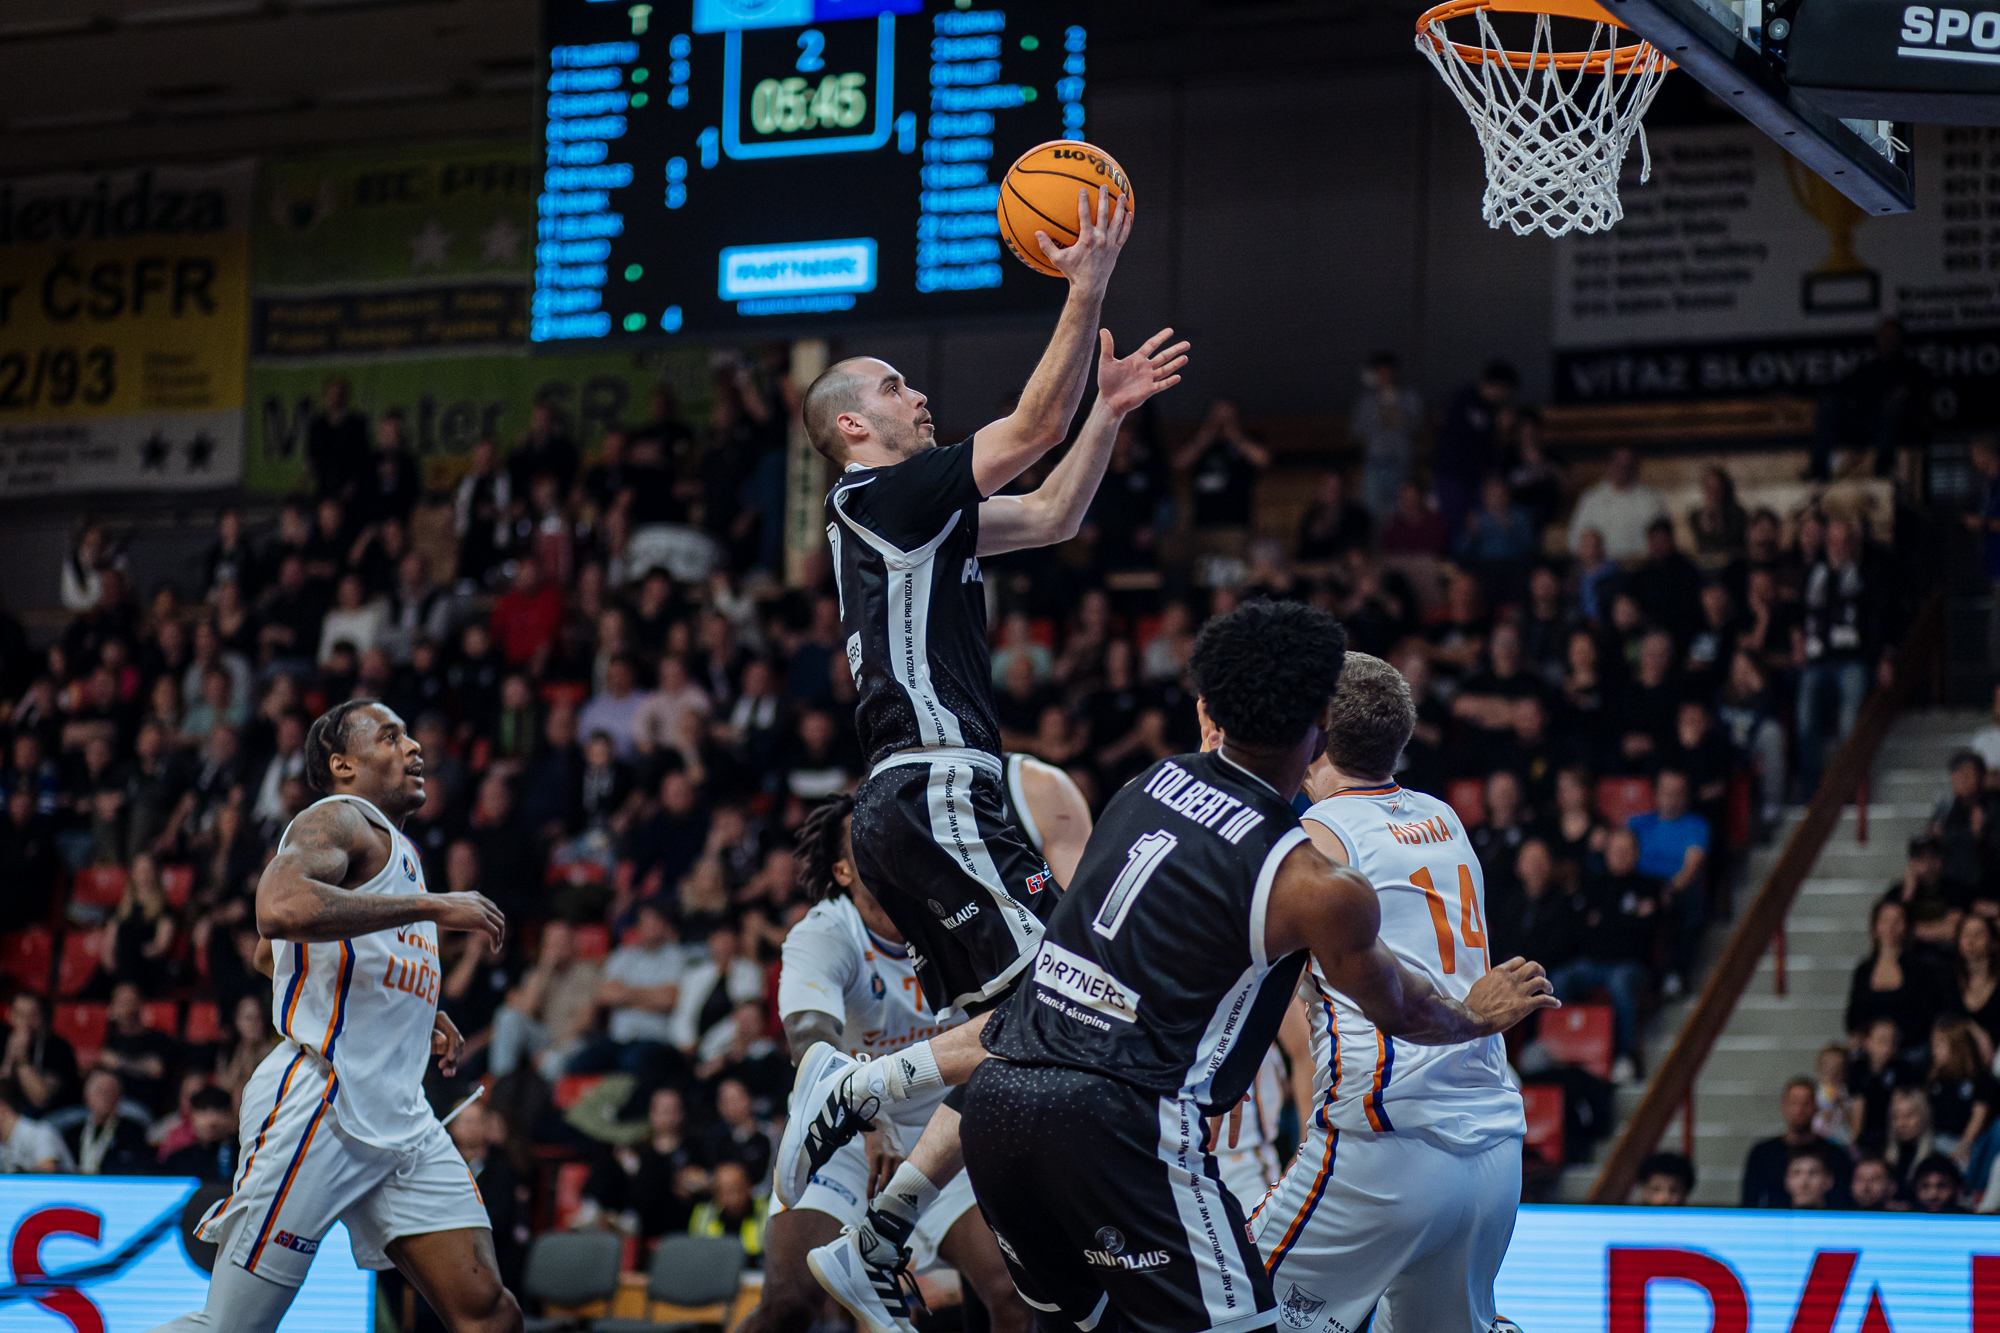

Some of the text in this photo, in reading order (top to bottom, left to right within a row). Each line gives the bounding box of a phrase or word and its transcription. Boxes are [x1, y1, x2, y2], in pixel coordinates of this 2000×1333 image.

[795, 29, 825, 72] 2
[751, 72, 867, 134] 05:45
[1053, 149, 1131, 202] Wilson
[42, 250, 217, 322] ČSFR
[904, 578, 913, 618] PRIEVIDZA
[904, 620, 913, 635] ARE
[905, 635, 913, 649] WE
[946, 799, 956, 813] ARE
[948, 813, 957, 825] WE
[1143, 760, 1265, 845] TOLBERT III
[1092, 828, 1179, 941] 1
[1408, 864, 1490, 976] 14
[1065, 1006, 1112, 1032] skupina
[1209, 990, 1249, 1070] WE ARE PRIEVIDZA
[1180, 1118, 1190, 1137] ARE
[1193, 1187, 1206, 1206] ARE
[1199, 1205, 1212, 1222] WE
[1208, 1228, 1231, 1277] PRIEVIDZA
[1221, 1277, 1233, 1297] ARE
[1223, 1296, 1237, 1309] WE
